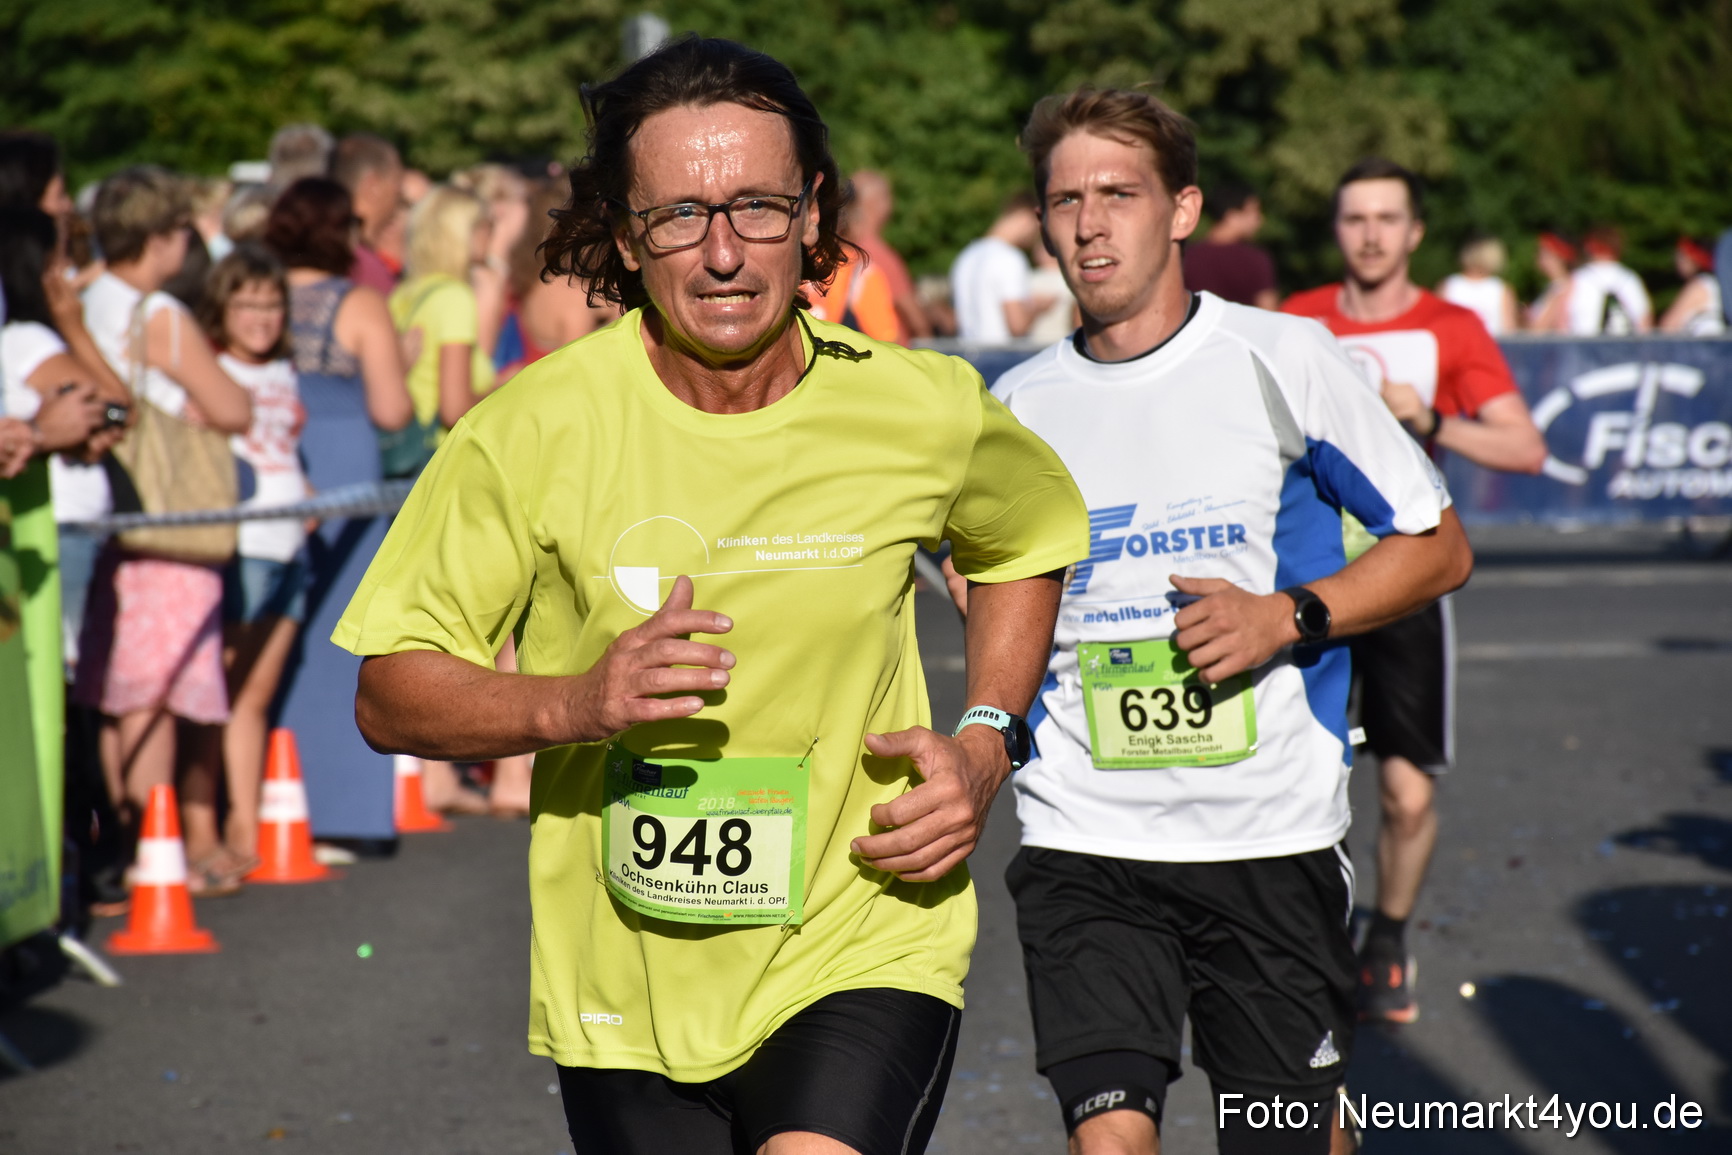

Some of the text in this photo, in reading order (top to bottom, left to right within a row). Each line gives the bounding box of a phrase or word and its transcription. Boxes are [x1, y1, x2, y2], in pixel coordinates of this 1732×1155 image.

[717, 532, 865, 549] Kliniken des Landkreises
[755, 548, 819, 561] Neumarkt
[1173, 549, 1216, 564] Metallbau
[1120, 685, 1213, 732] 639
[1128, 732, 1213, 748] Enigk Sascha
[1121, 744, 1222, 756] Forster Metallbau GmbH
[697, 797, 736, 811] 2018
[632, 814, 752, 877] 948
[621, 863, 717, 894] Ochsenkühn
[722, 881, 769, 894] Claus
[609, 869, 631, 890] Kliniken
[631, 885, 645, 896] des
[647, 891, 702, 905] Landkreises
[704, 897, 748, 906] Neumarkt
[750, 897, 756, 905] i.
[757, 897, 766, 905] d.
[768, 896, 788, 905] OPf.
[580, 1013, 623, 1025] PIRO
[1084, 1090, 1126, 1113] cep
